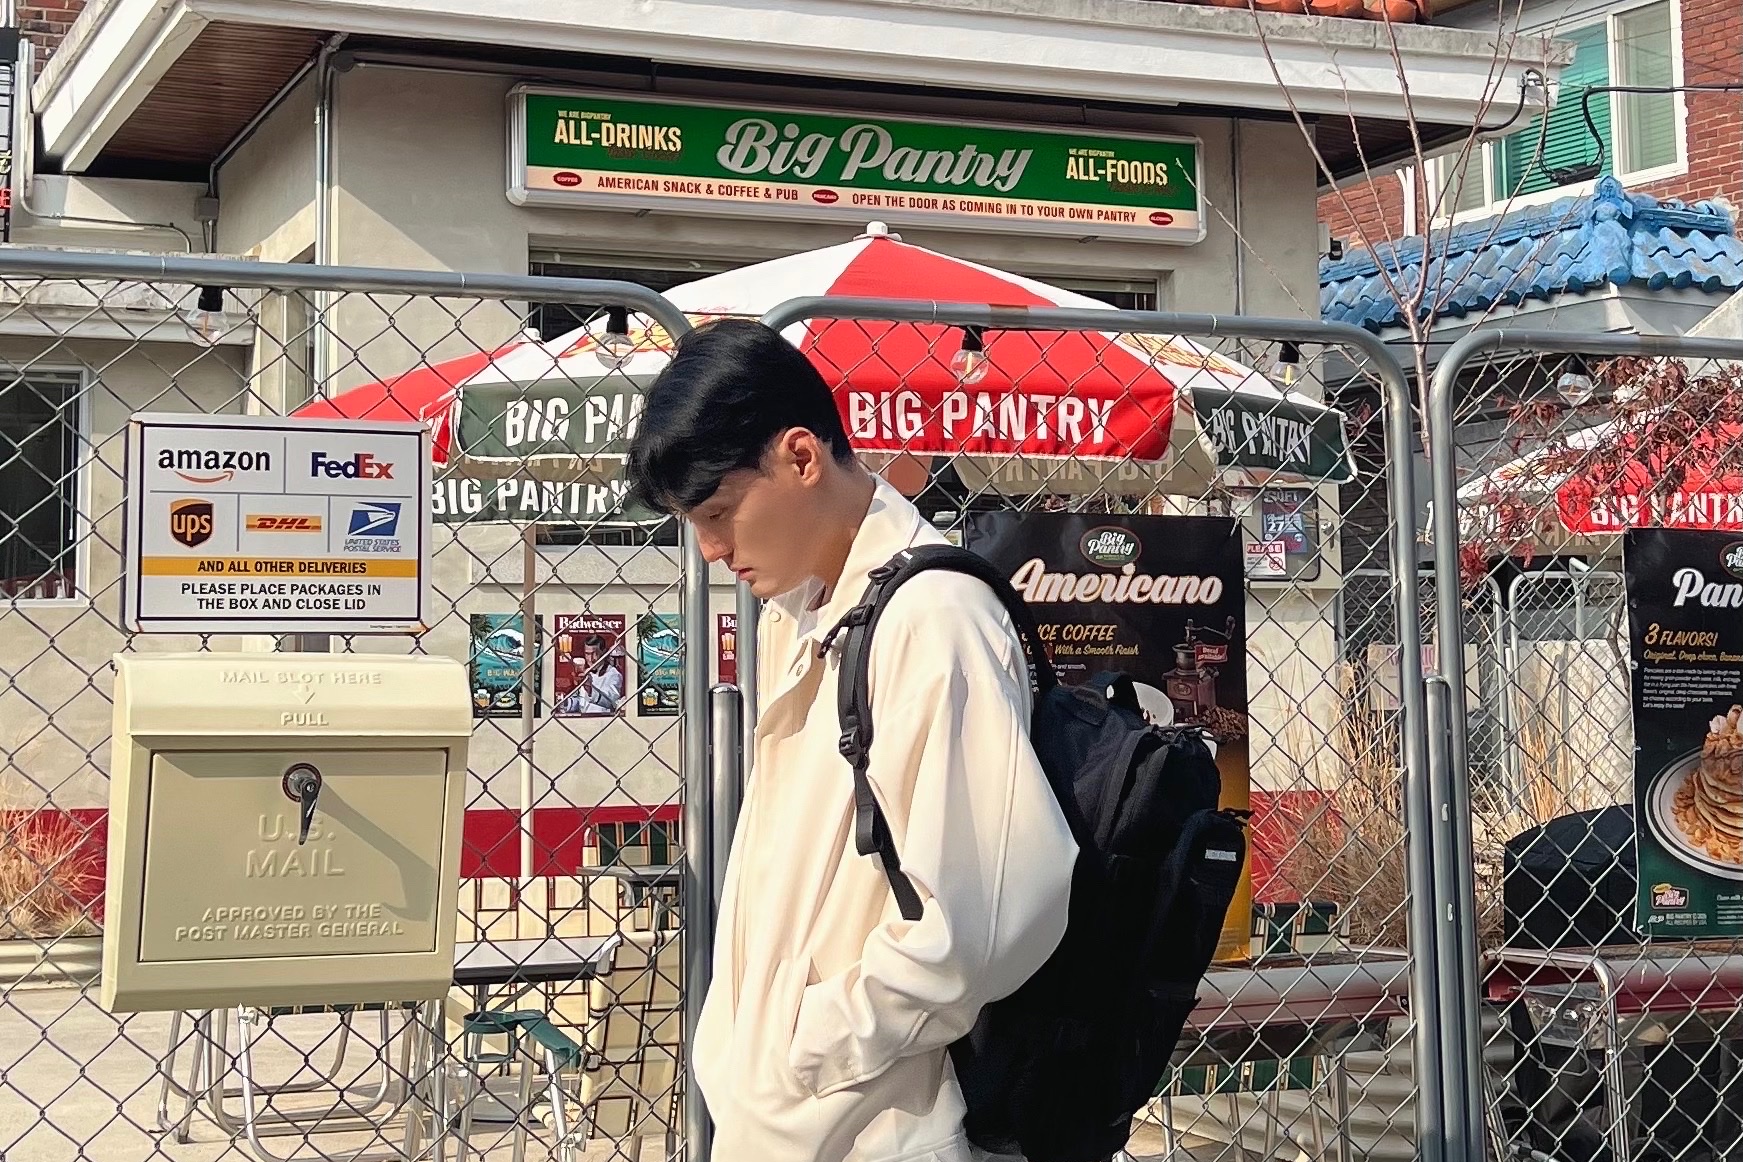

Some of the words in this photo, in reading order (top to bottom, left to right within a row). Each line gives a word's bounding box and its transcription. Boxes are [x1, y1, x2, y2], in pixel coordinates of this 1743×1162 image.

[554, 118, 682, 152] ALL-DRINKS
[716, 117, 836, 179] Big
[838, 123, 1034, 192] Pantry
[1066, 156, 1168, 186] ALL-FOODS
[597, 175, 659, 192] AMERICAN
[663, 180, 702, 196] SNACK
[706, 183, 714, 195] &
[718, 184, 760, 198] COFFEE
[764, 187, 772, 199] &
[776, 188, 798, 201] PUB
[852, 193, 881, 206] OPEN
[885, 195, 905, 207] THE
[909, 197, 938, 209] DOOR
[942, 199, 956, 211] AS
[959, 200, 1002, 214] COMING
[1006, 203, 1017, 215] IN
[1020, 205, 1034, 216] TO
[1037, 206, 1065, 218] YOUR
[1068, 208, 1094, 220] OWN
[1097, 210, 1137, 223] PANTRY
[505, 397, 571, 448] BIG
[847, 390, 925, 441] BIG
[942, 392, 1115, 445] PANTRY
[1211, 407, 1238, 454] BIG
[158, 448, 271, 472] amazon
[311, 451, 395, 480] FedEx
[431, 477, 484, 516] BIG
[496, 477, 632, 517] PANTRY
[173, 513, 212, 542] ups
[256, 516, 313, 531] DHL
[343, 545, 371, 553] POSTAL
[373, 545, 402, 553] SERVICE
[344, 538, 372, 546] UNITED
[374, 539, 400, 547] STATES
[1087, 538, 1135, 556] Pantry
[1099, 531, 1127, 547] Big
[197, 560, 224, 573] AND
[228, 560, 250, 573] ALL
[254, 561, 294, 574] OTHER
[298, 562, 367, 575] DELIVERIES
[181, 582, 236, 596] PLEASE
[240, 583, 286, 596] PLACE
[290, 584, 363, 597] PACKAGES
[368, 584, 381, 597] IN
[1010, 557, 1224, 605] Americano
[197, 597, 225, 610] THE
[228, 597, 259, 611] BOX
[261, 598, 292, 611] AND
[296, 598, 341, 611] CLOSE
[344, 598, 366, 611] LID
[558, 616, 623, 630] Budweiser
[1062, 624, 1117, 640] COFFEE
[1645, 622, 1661, 645] 3
[1660, 631, 1719, 647] FLAVORS!
[1054, 643, 1075, 656] With
[1075, 647, 1082, 656] a
[1083, 643, 1114, 656] Smooth
[1115, 643, 1140, 656] Finish
[220, 670, 270, 684] MAIL
[276, 671, 325, 684] SLOT
[331, 671, 383, 685] HERE
[280, 711, 330, 727] PULL
[245, 849, 346, 879] MAIL
[201, 906, 306, 924] APPROVED
[312, 904, 338, 920] BY
[345, 903, 382, 919] THE
[175, 925, 228, 943] POST
[233, 922, 313, 941] MASTER
[317, 920, 405, 939] GENERAL
